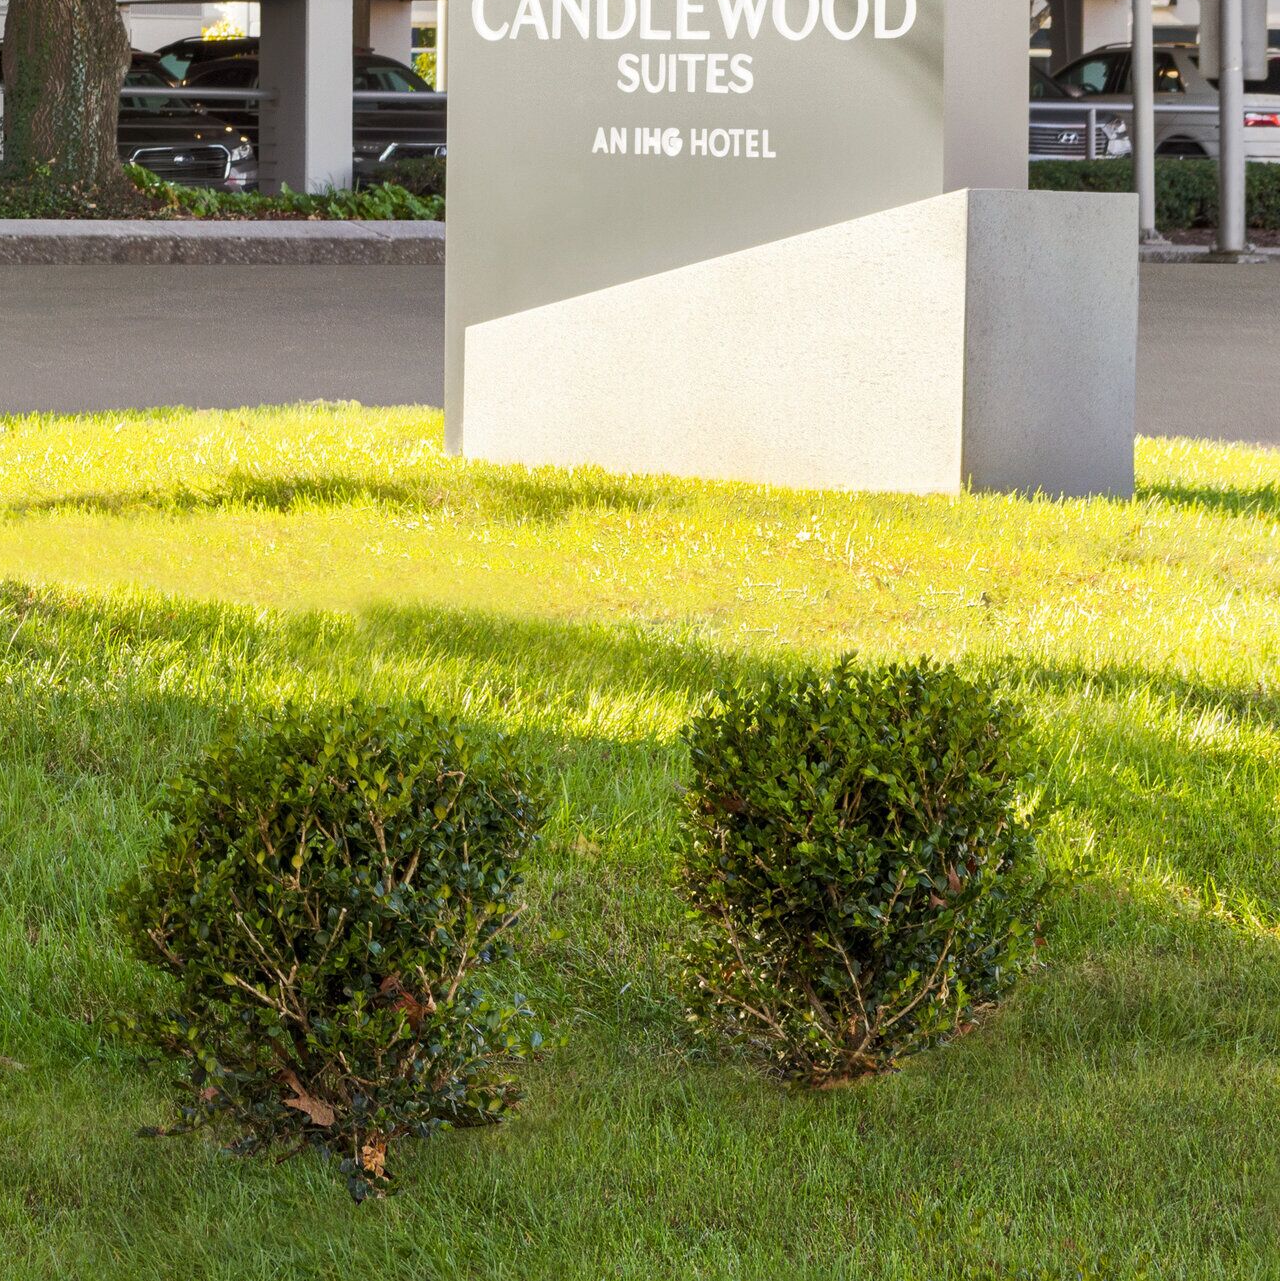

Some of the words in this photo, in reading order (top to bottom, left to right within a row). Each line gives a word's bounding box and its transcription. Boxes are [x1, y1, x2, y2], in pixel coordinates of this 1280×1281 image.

[617, 53, 754, 94] SUITES
[592, 126, 627, 154] AN
[634, 127, 683, 157] IHG
[690, 128, 777, 158] HOTEL
